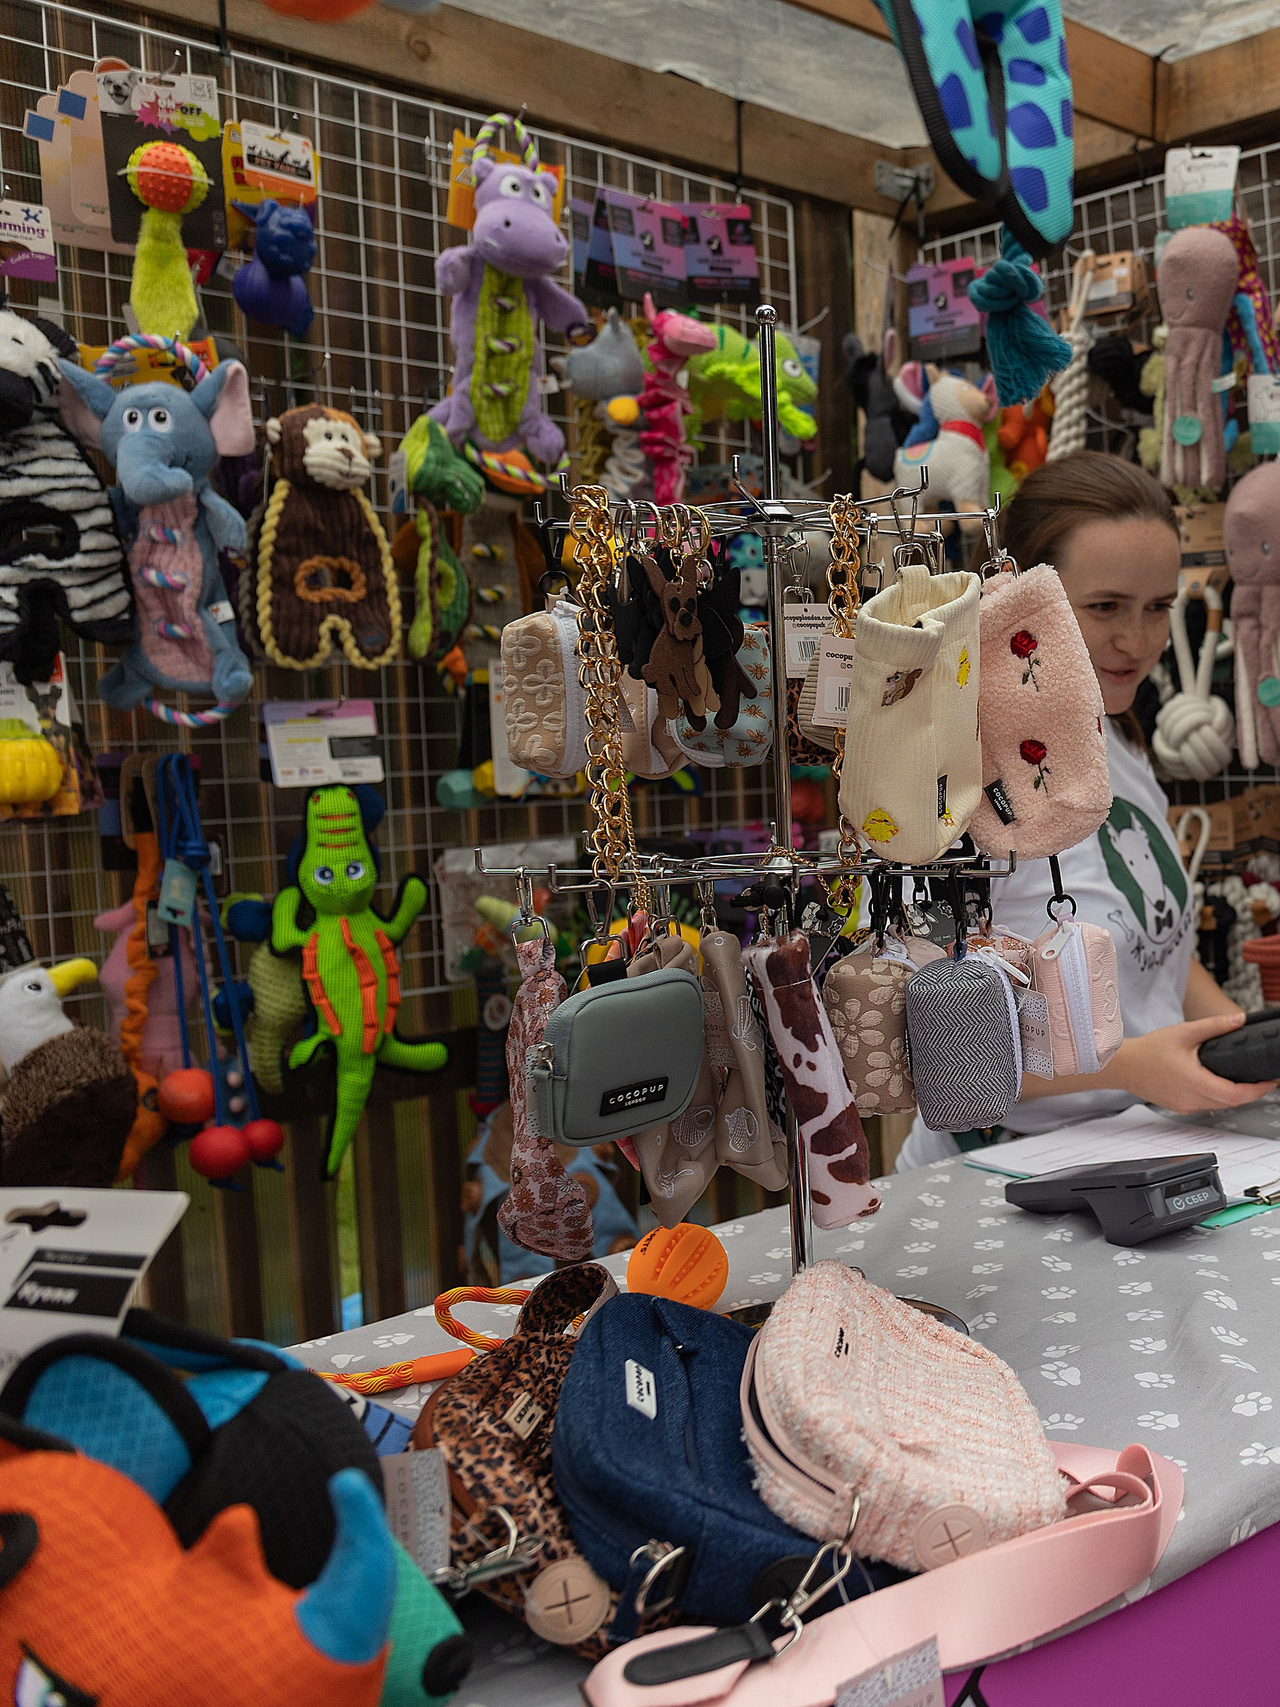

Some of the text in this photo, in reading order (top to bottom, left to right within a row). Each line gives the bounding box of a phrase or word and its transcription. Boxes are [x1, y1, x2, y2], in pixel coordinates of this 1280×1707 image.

[784, 614, 833, 623] ocopuplondon.com
[825, 651, 854, 662] cocopu
[992, 787, 1013, 816] COCOPUP
[704, 1024, 727, 1032] COPUP
[1020, 1022, 1046, 1037] COPUP
[608, 1083, 665, 1105] COCOPUP
[624, 1096, 647, 1107] LONDON
[1185, 1192, 1209, 1205] СБЕР
[397, 1465, 410, 1542] COCOP
